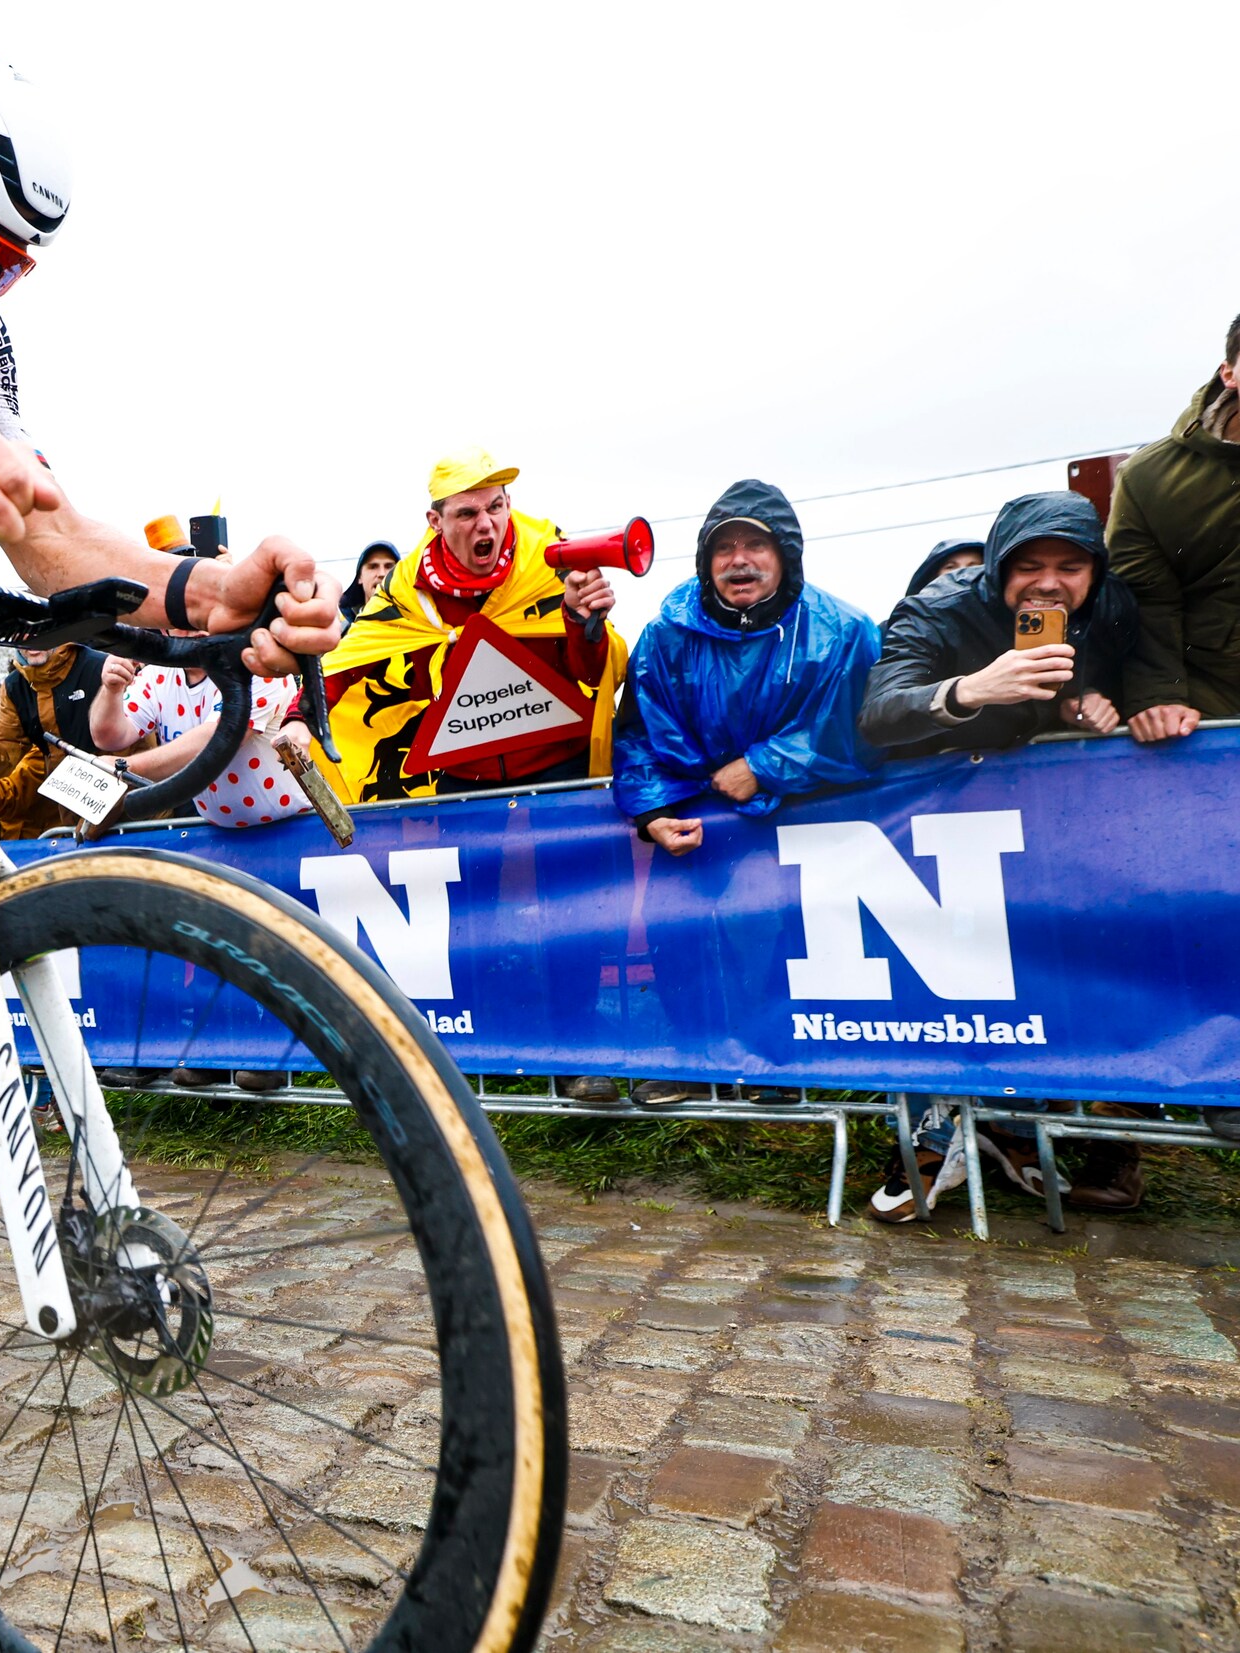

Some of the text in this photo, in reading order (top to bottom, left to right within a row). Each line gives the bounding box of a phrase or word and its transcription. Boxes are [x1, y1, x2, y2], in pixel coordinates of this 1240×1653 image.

[32, 181, 64, 209] CANYON
[457, 680, 534, 708] Opgelet
[447, 700, 553, 734] Supporter
[66, 762, 109, 792] Ik ben de
[46, 775, 108, 816] pedalen kwijt
[776, 809, 1025, 1001] N
[300, 846, 462, 1000] N
[791, 1013, 1047, 1045] Nieuwsblad
